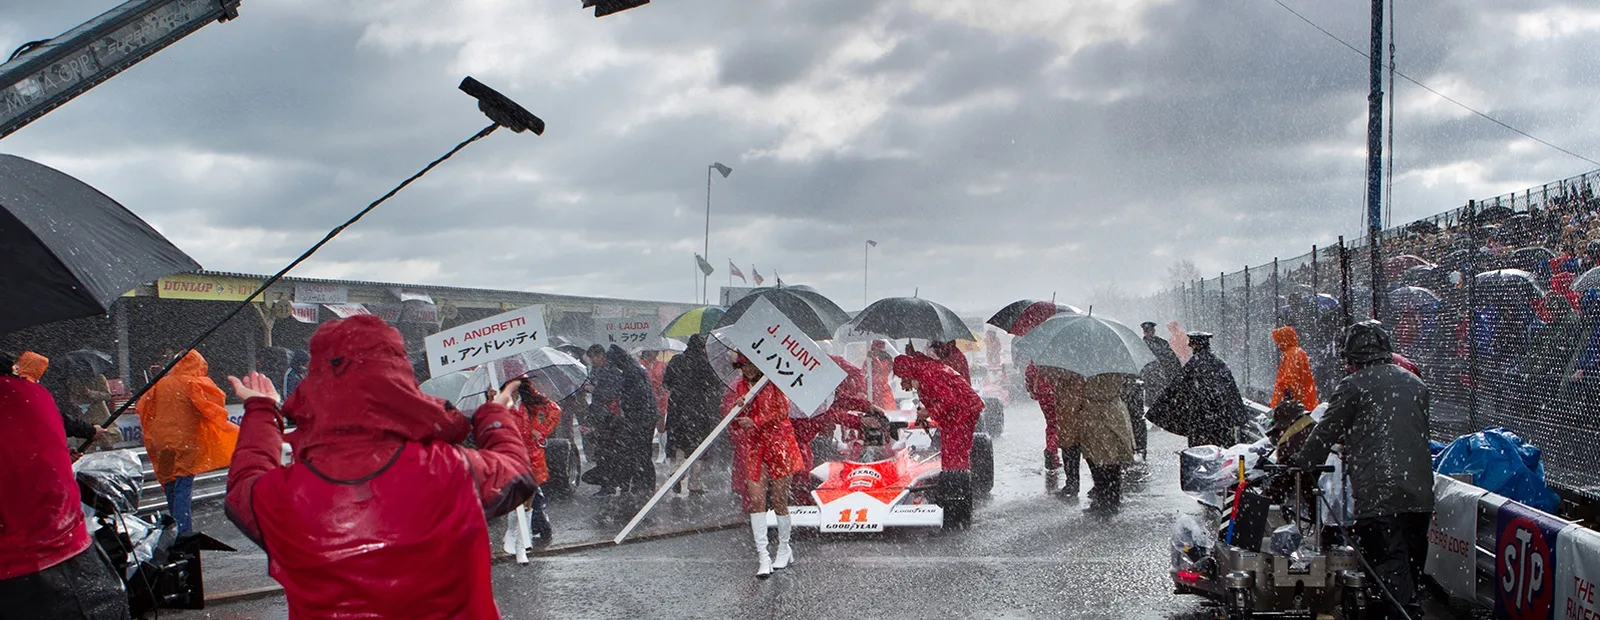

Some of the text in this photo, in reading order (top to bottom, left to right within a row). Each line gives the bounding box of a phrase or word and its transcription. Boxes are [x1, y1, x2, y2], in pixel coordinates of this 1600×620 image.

[59, 54, 90, 82] GRIP
[163, 280, 213, 293] DUNLOP
[443, 316, 526, 348] M. ANDRETTI
[606, 322, 649, 331] N. LAUDA
[608, 333, 648, 342] N. ラウダ
[440, 330, 538, 366] M. アンドレッティ
[767, 324, 821, 371] J. HUNT
[751, 338, 804, 388] J. ハント
[849, 469, 880, 478] TEXACO
[826, 522, 878, 531] GOODYEAR
[838, 508, 868, 523] 11
[1449, 536, 1469, 558] EDGE
[1502, 528, 1544, 609] STP
[1574, 575, 1595, 604] THE
